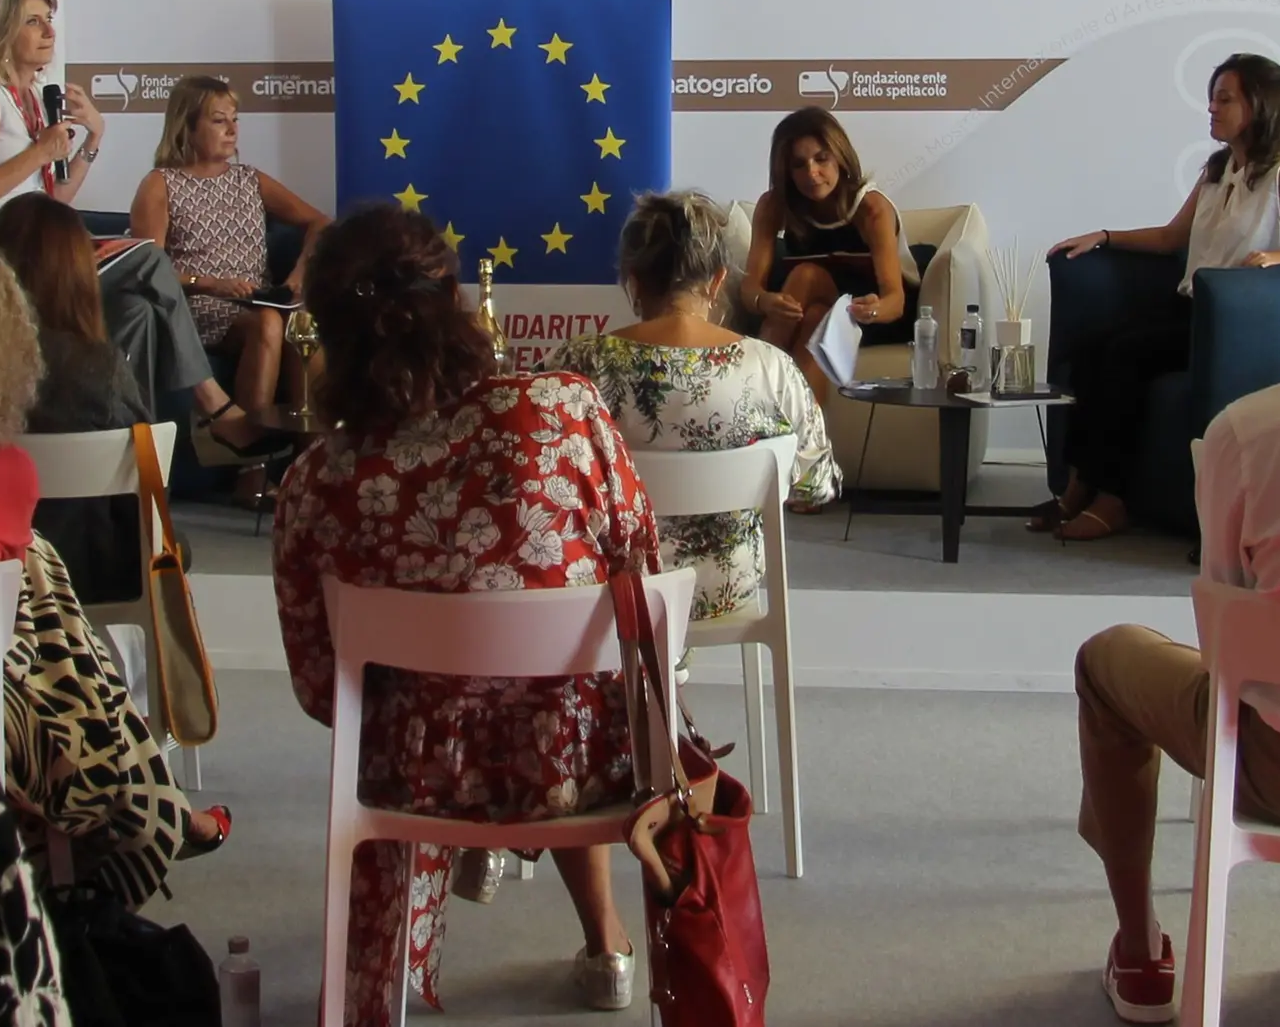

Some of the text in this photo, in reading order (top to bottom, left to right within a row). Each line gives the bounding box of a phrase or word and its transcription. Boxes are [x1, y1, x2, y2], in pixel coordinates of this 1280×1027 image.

[852, 71, 947, 84] fondazione ente
[142, 86, 170, 100] dello
[853, 84, 947, 99] dello spettacolo
[503, 314, 610, 340] IDARITY
